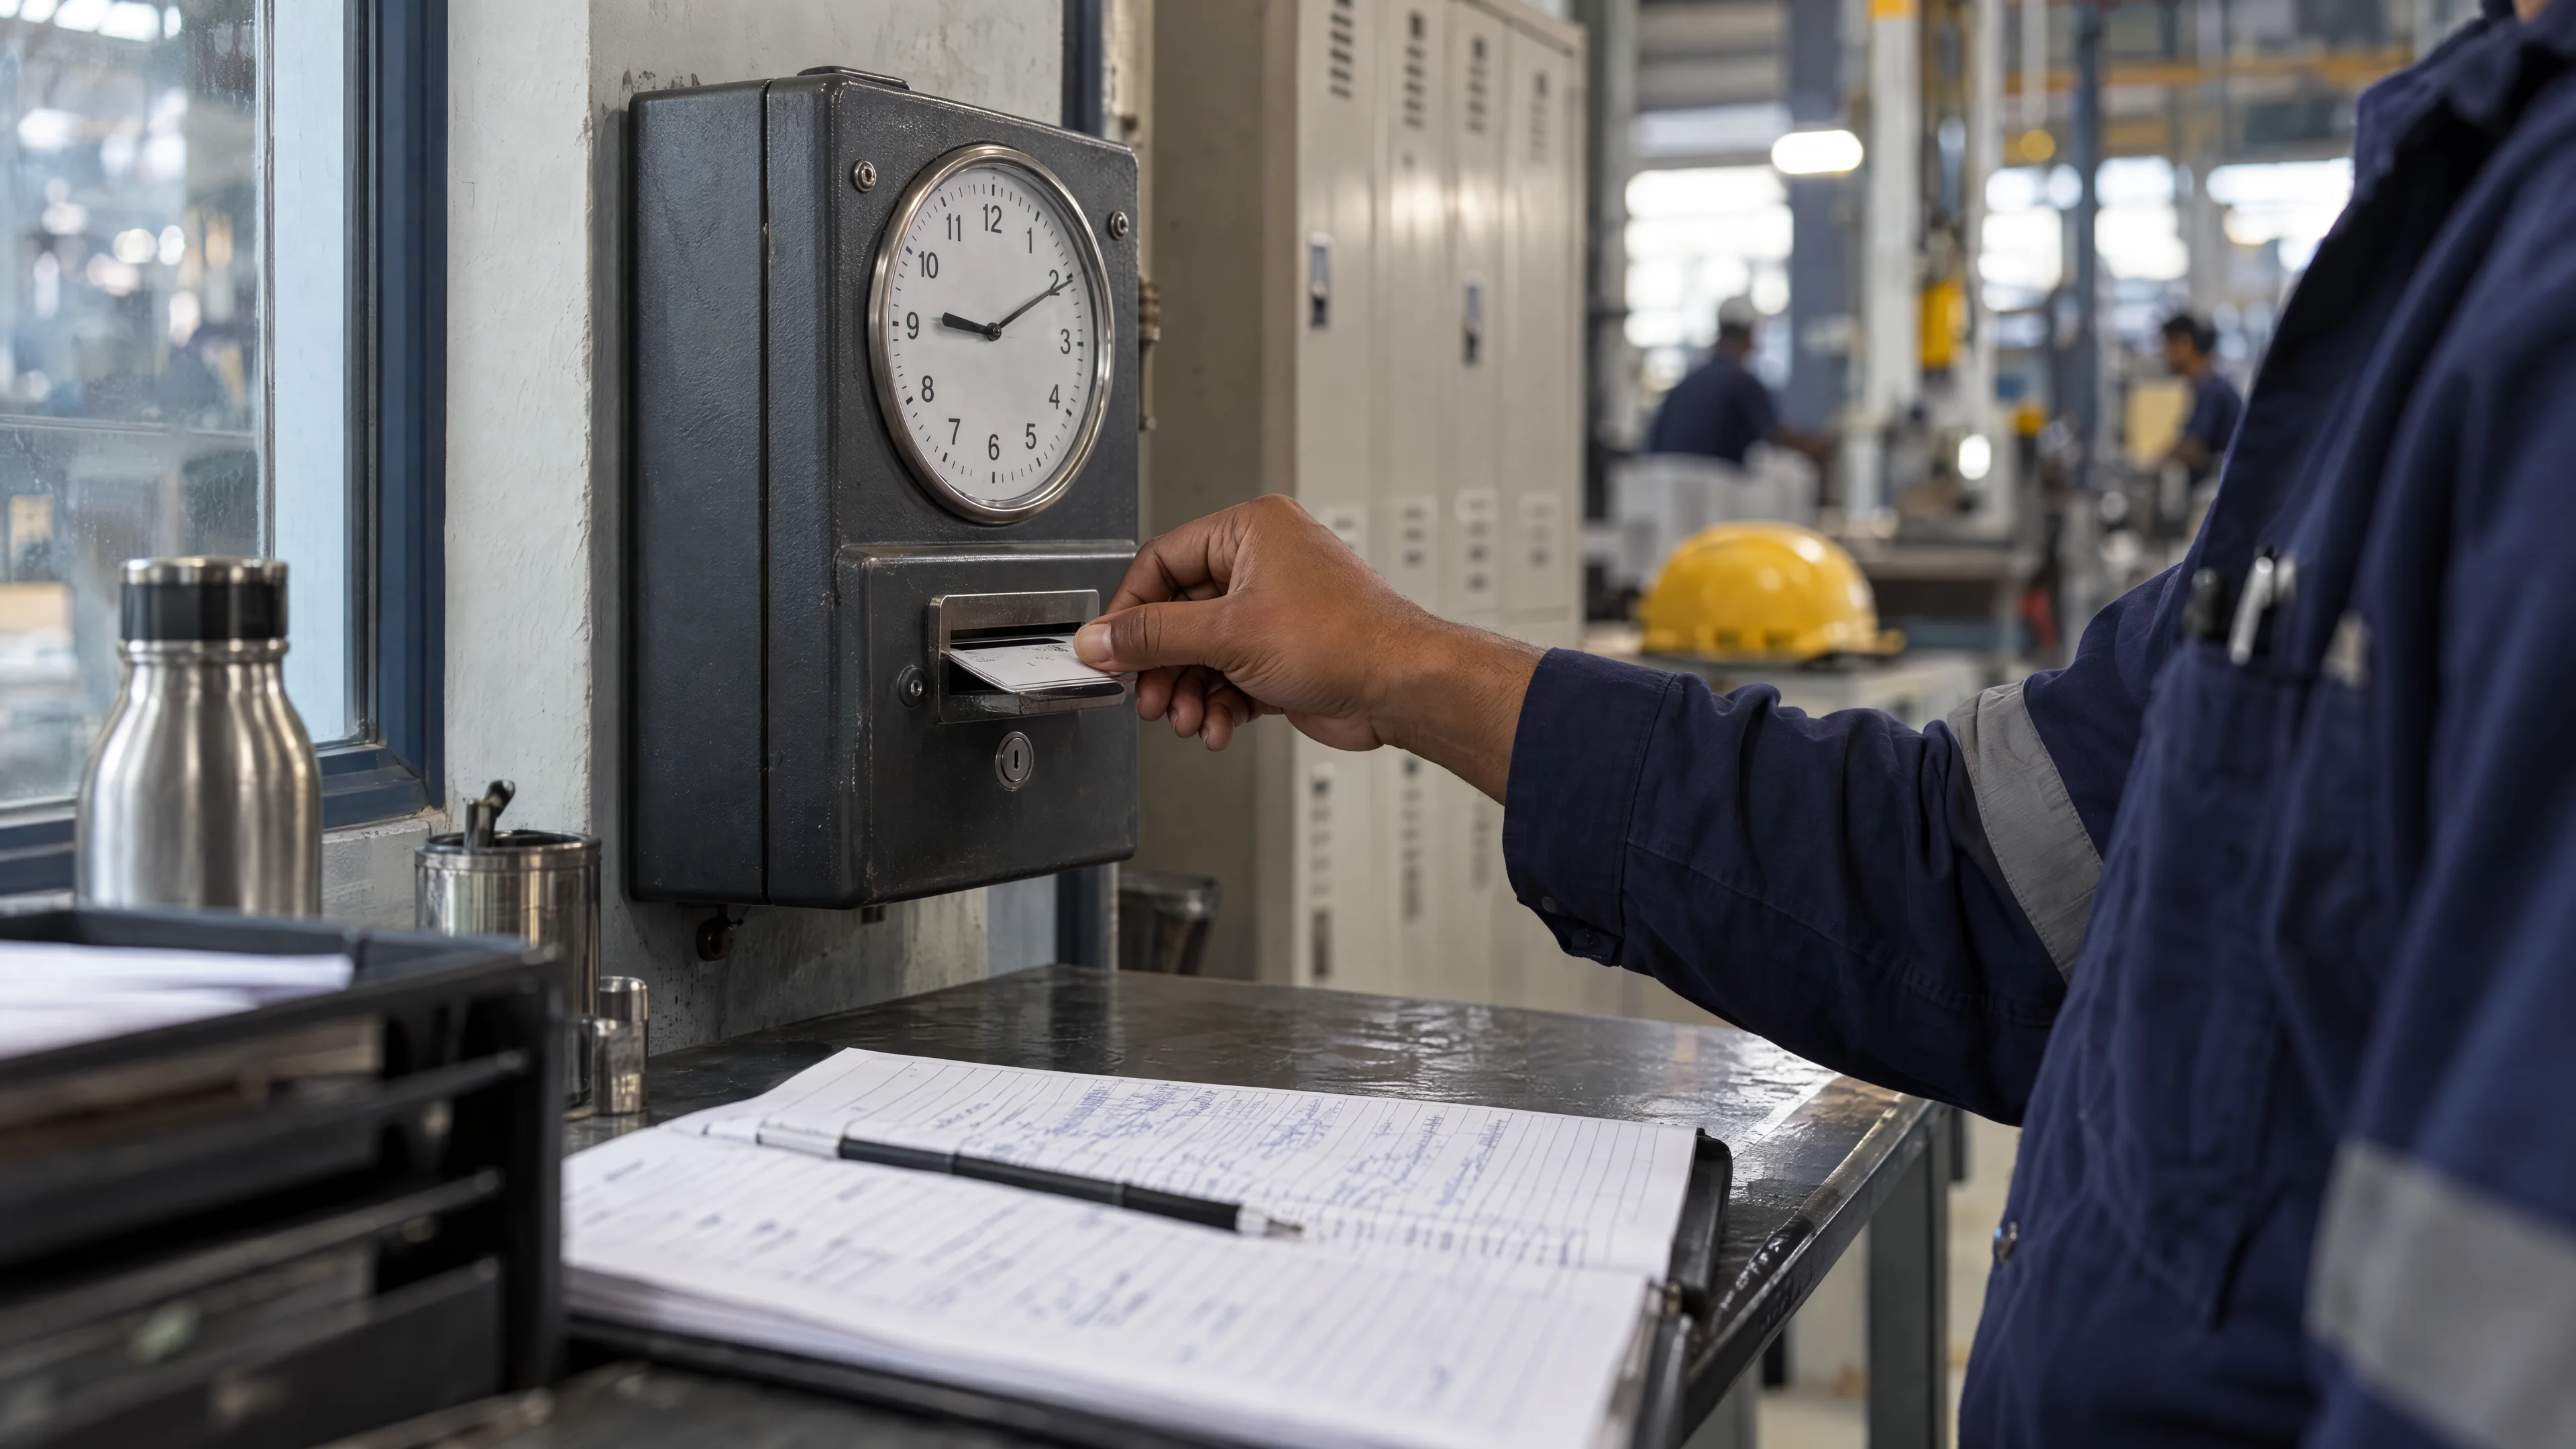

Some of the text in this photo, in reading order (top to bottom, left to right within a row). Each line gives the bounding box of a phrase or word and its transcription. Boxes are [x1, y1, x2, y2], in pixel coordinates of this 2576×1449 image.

[946, 213, 961, 241] 11
[983, 204, 1002, 233] 12
[1026, 227, 1032, 254] 1
[918, 251, 938, 279] 10
[1049, 269, 1060, 296] 2
[906, 311, 920, 339] 9
[1061, 329, 1071, 354] 3
[921, 375, 934, 402] 8
[1049, 384, 1061, 410] 4
[948, 418, 961, 445] 7
[1025, 423, 1036, 449] 5
[988, 434, 1000, 461] 6
